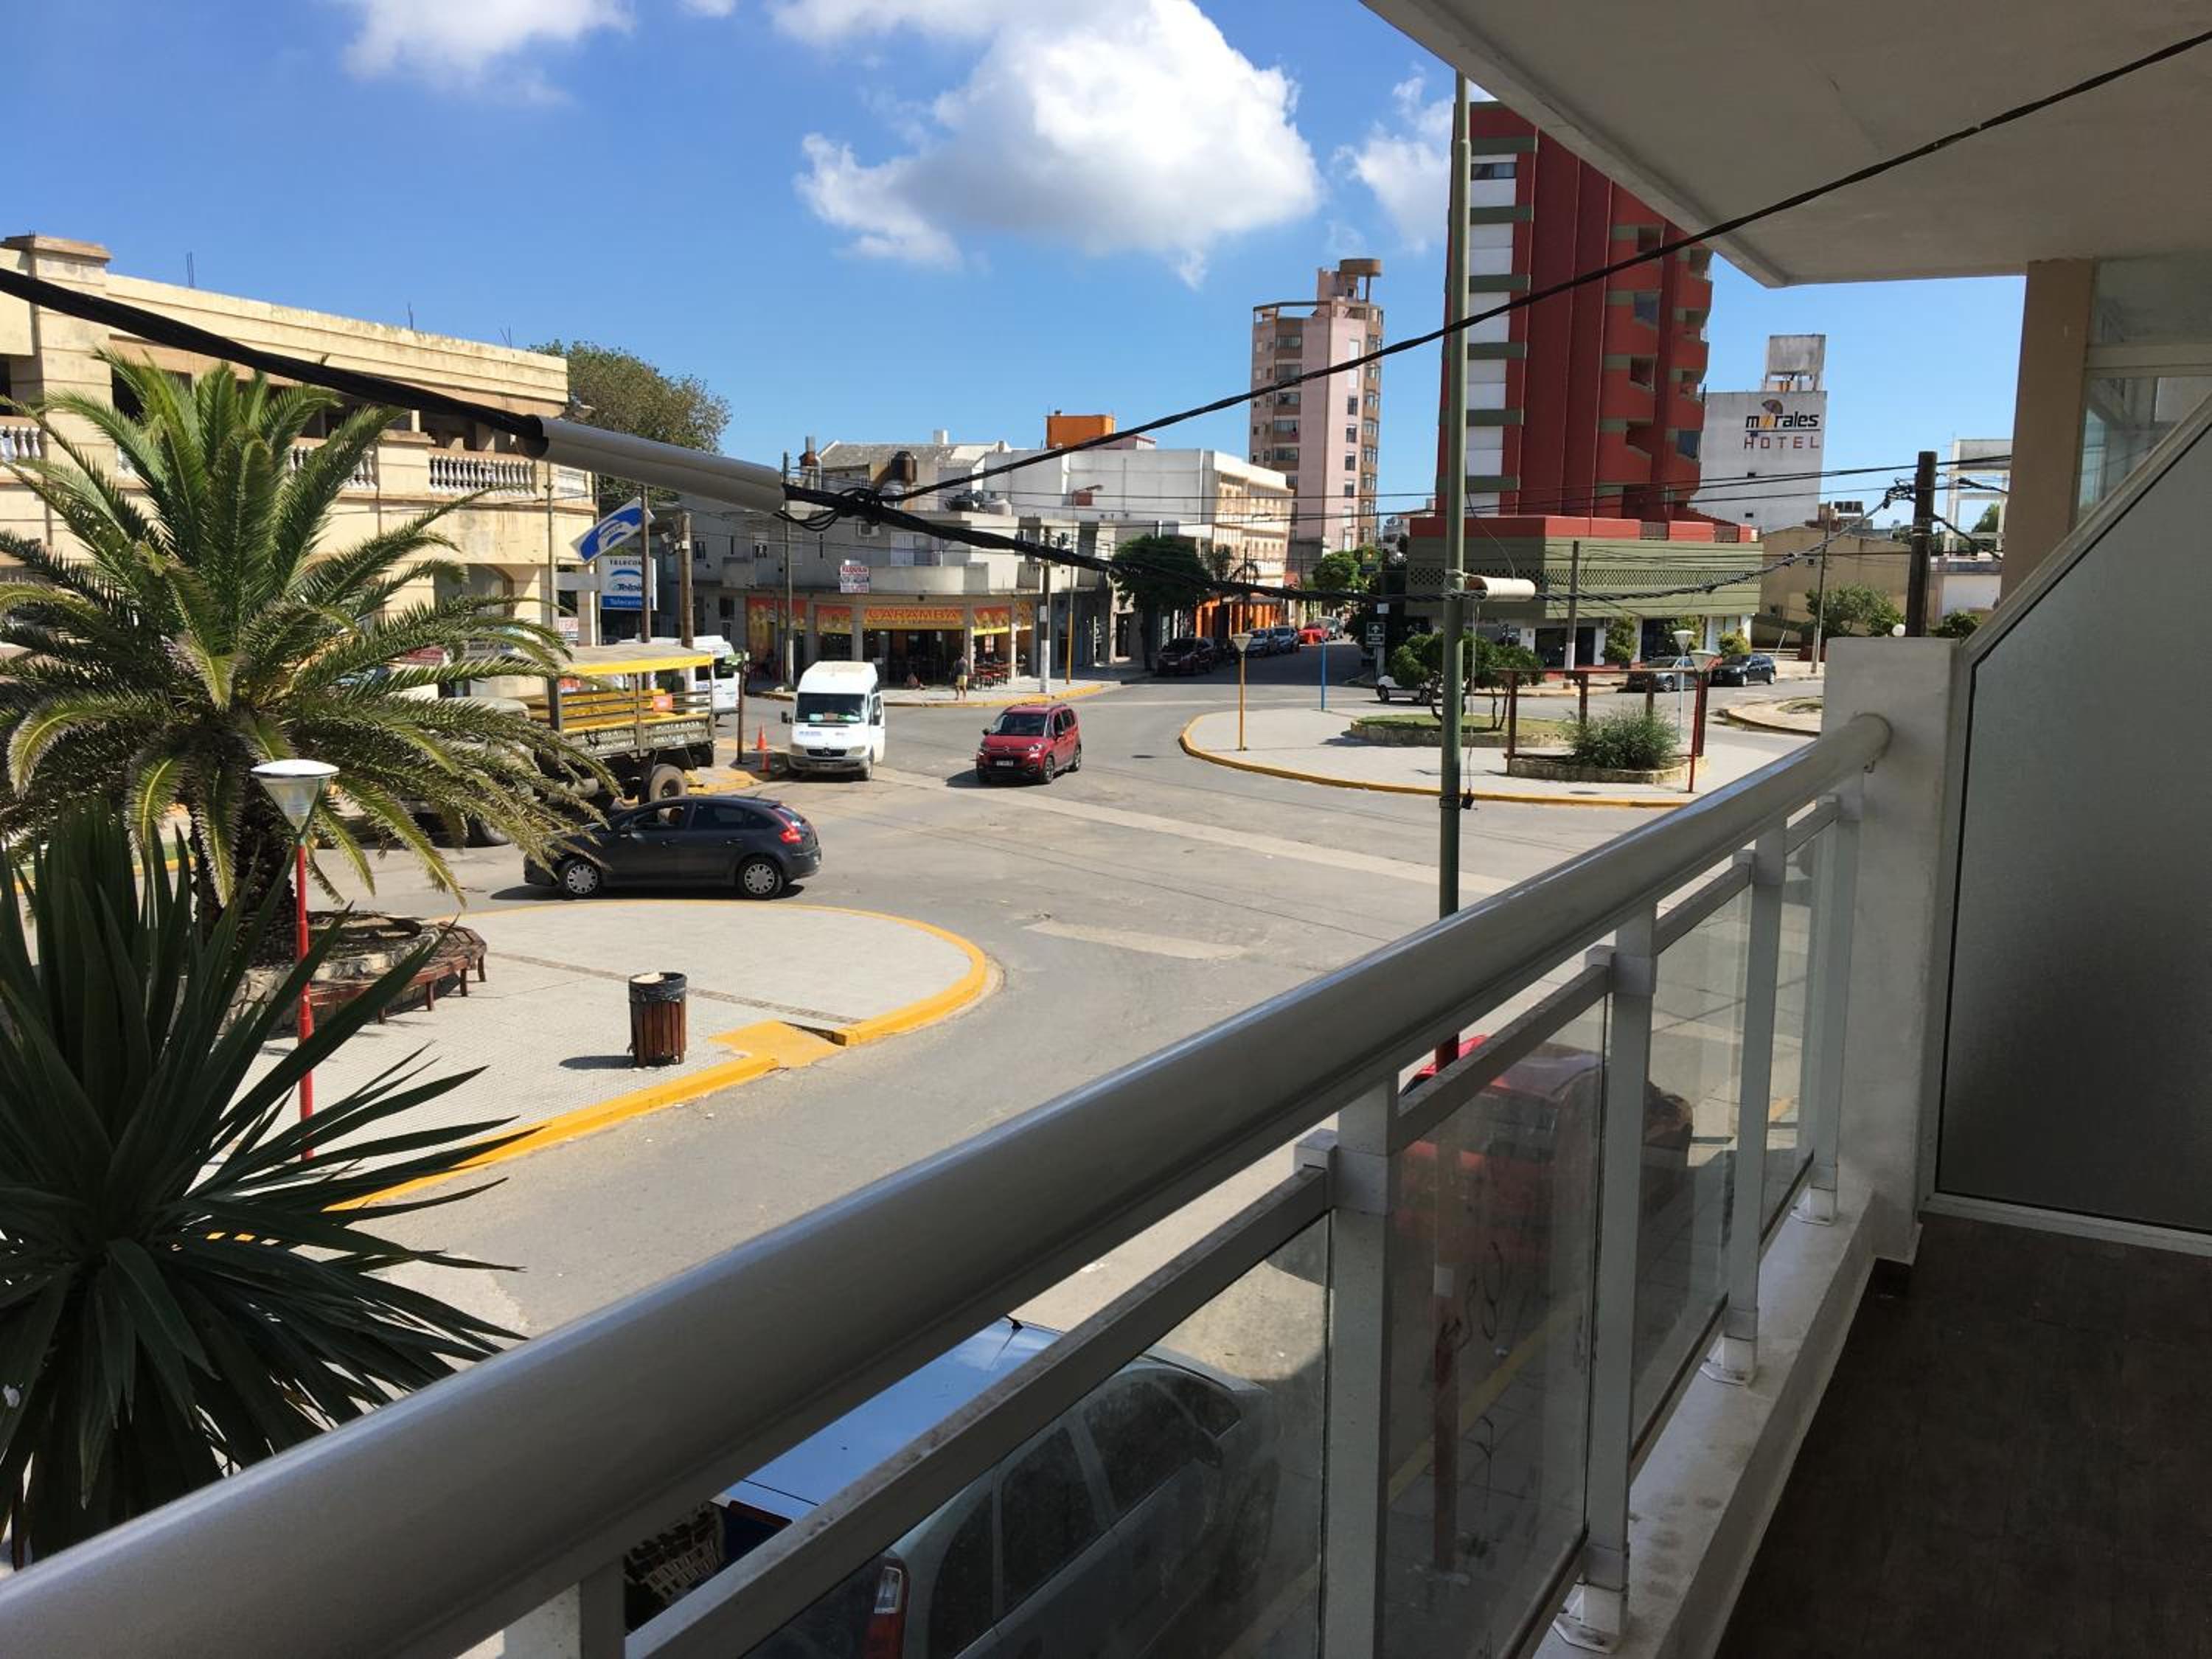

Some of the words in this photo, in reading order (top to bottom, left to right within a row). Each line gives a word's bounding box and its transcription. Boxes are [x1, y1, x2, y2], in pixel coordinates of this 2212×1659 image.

[1746, 411, 1820, 428] morales
[1745, 436, 1819, 449] HOTEL
[868, 608, 958, 619] CARAMBA
